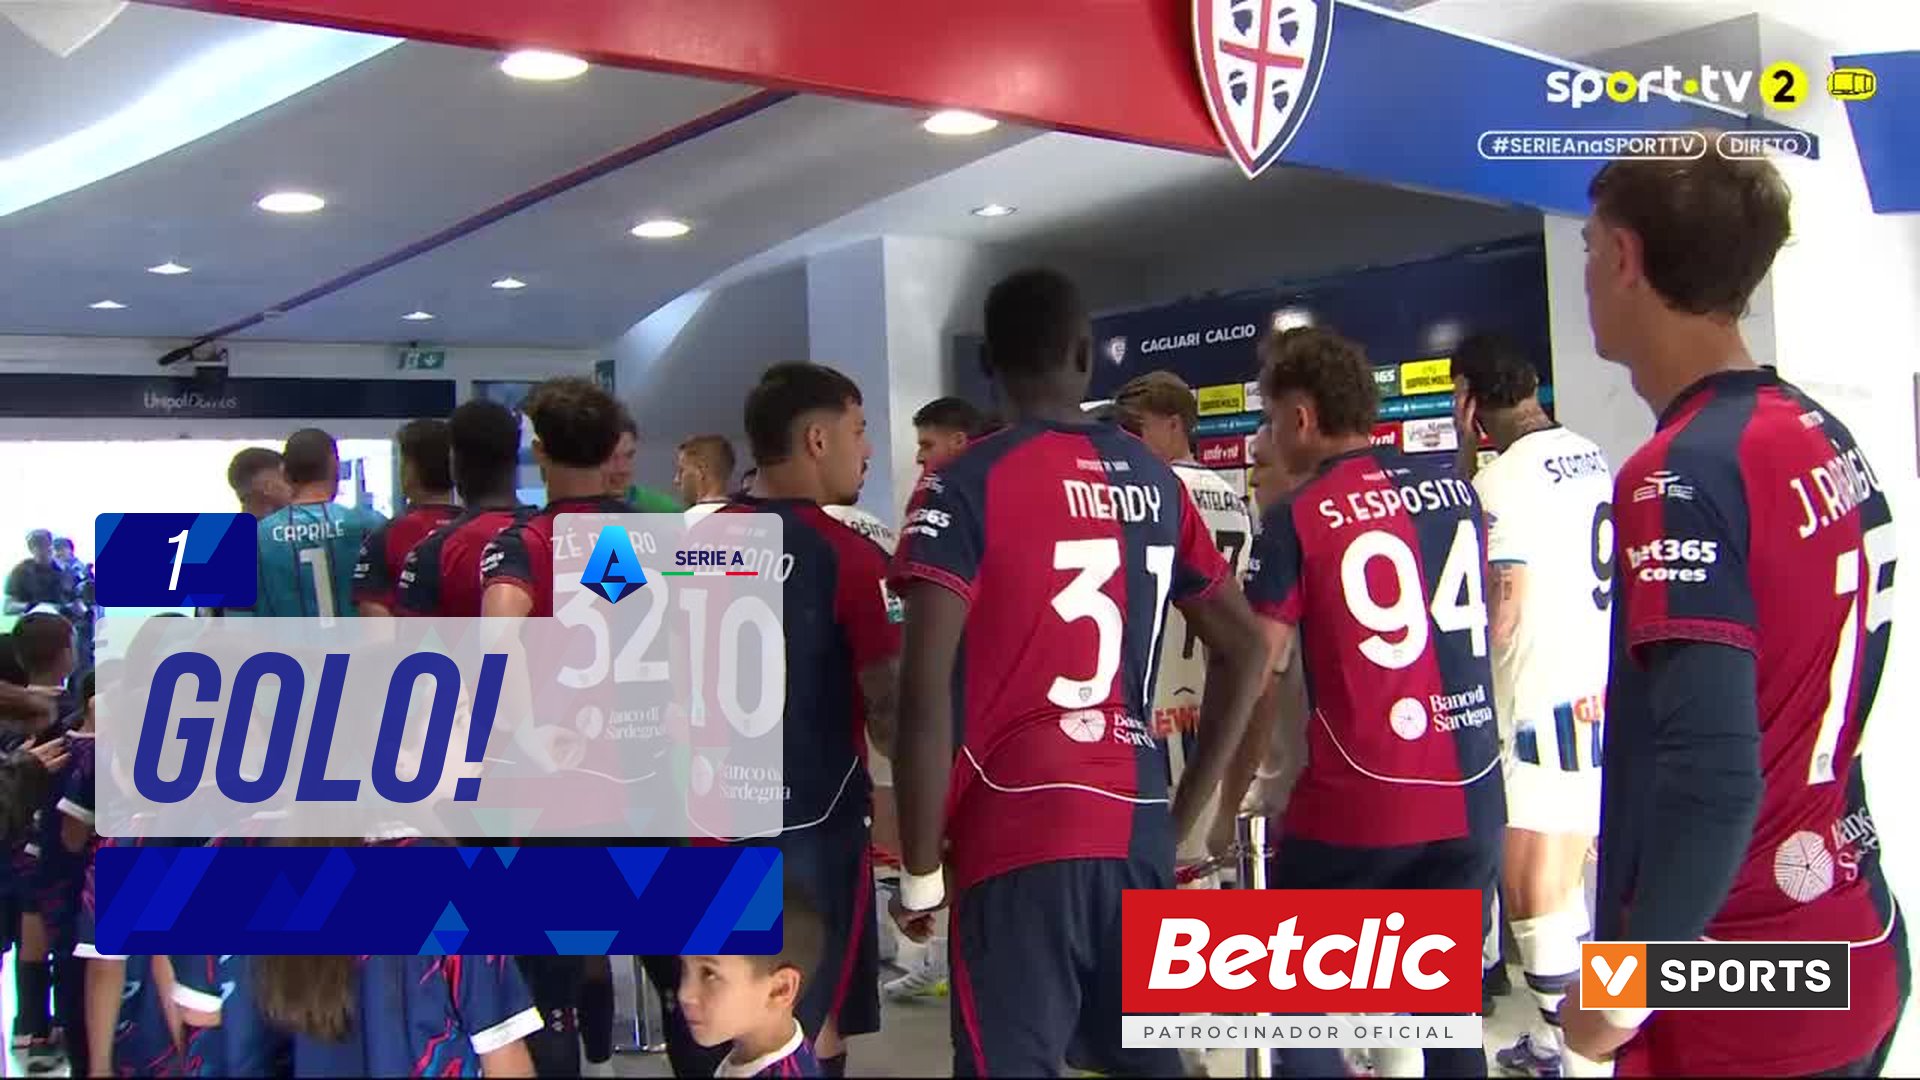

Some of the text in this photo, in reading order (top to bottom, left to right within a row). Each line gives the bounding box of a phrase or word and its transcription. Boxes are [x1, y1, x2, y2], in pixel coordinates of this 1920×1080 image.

[1140, 324, 1256, 354] CAGLIARI CALCIO
[1062, 479, 1161, 523] MENDY
[1319, 479, 1472, 529] S.ESPOSITO
[273, 520, 345, 542] CAPRILE
[1626, 538, 1718, 569] bet365
[299, 547, 336, 629] 1
[1340, 518, 1489, 670] 94
[1639, 567, 1707, 582] cores
[555, 566, 670, 689] 32
[1047, 537, 1175, 709] 31
[679, 587, 785, 738] 10
